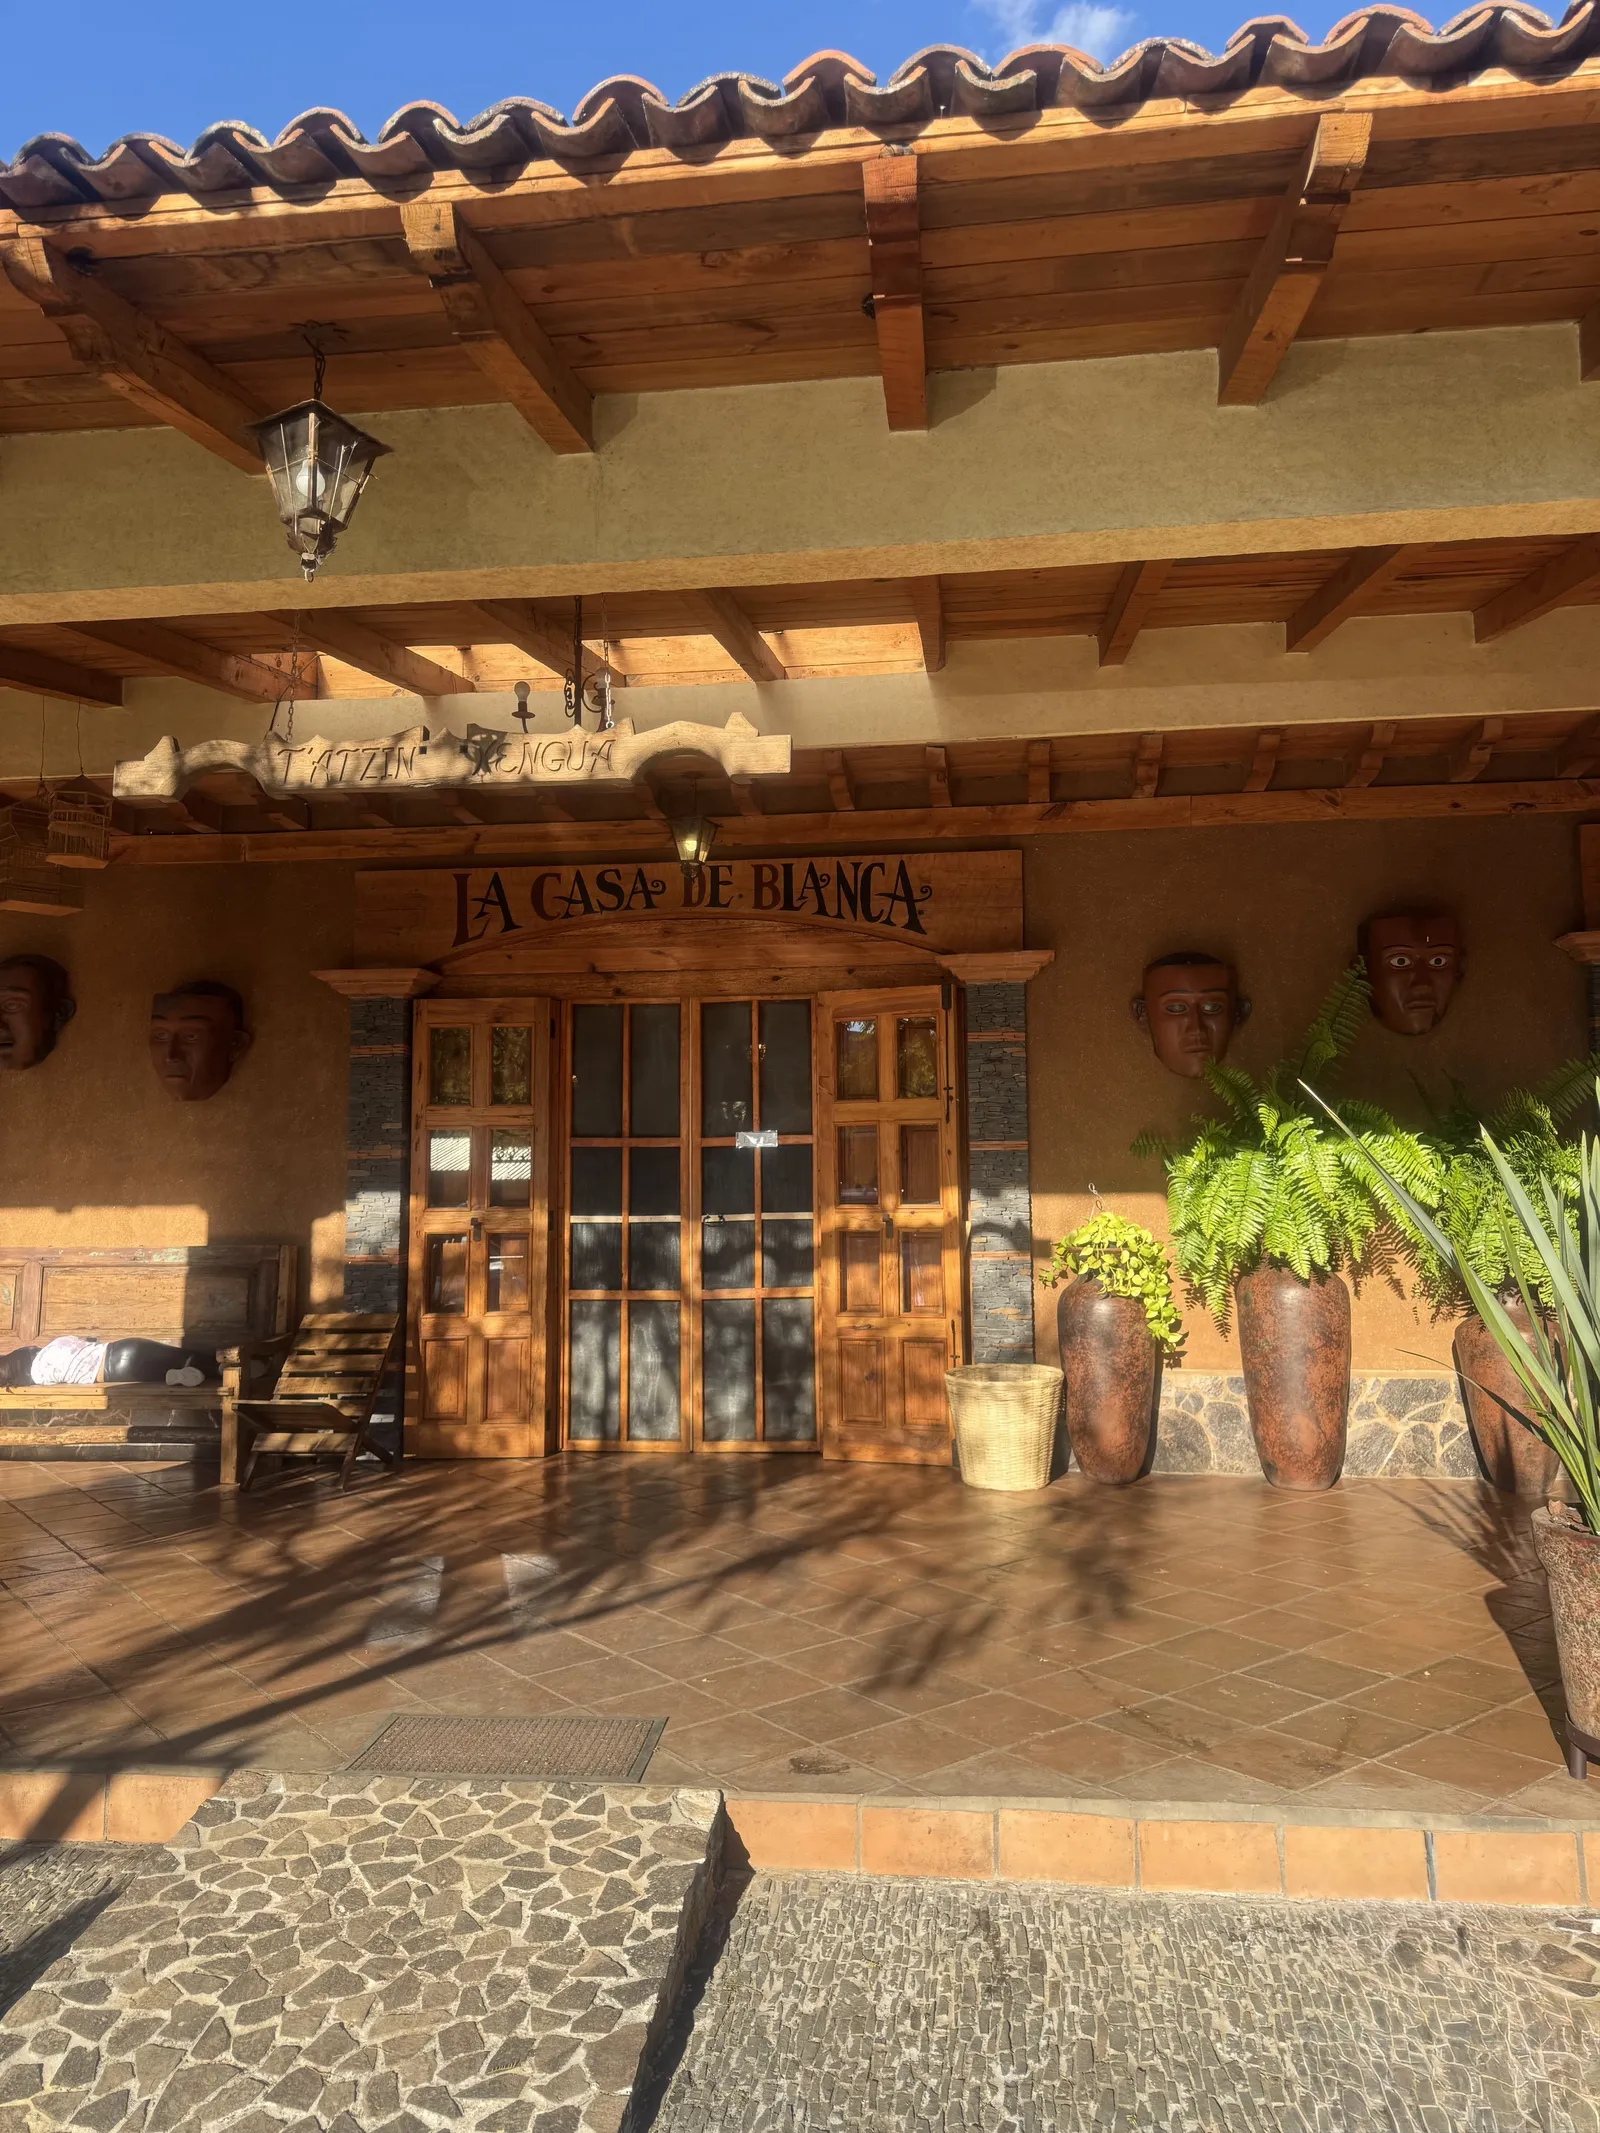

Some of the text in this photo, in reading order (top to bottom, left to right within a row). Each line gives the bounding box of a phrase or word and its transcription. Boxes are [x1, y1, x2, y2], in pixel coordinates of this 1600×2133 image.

[277, 746, 417, 784] T'ATZIN
[451, 859, 932, 948] LA CASA DE BLANCA
